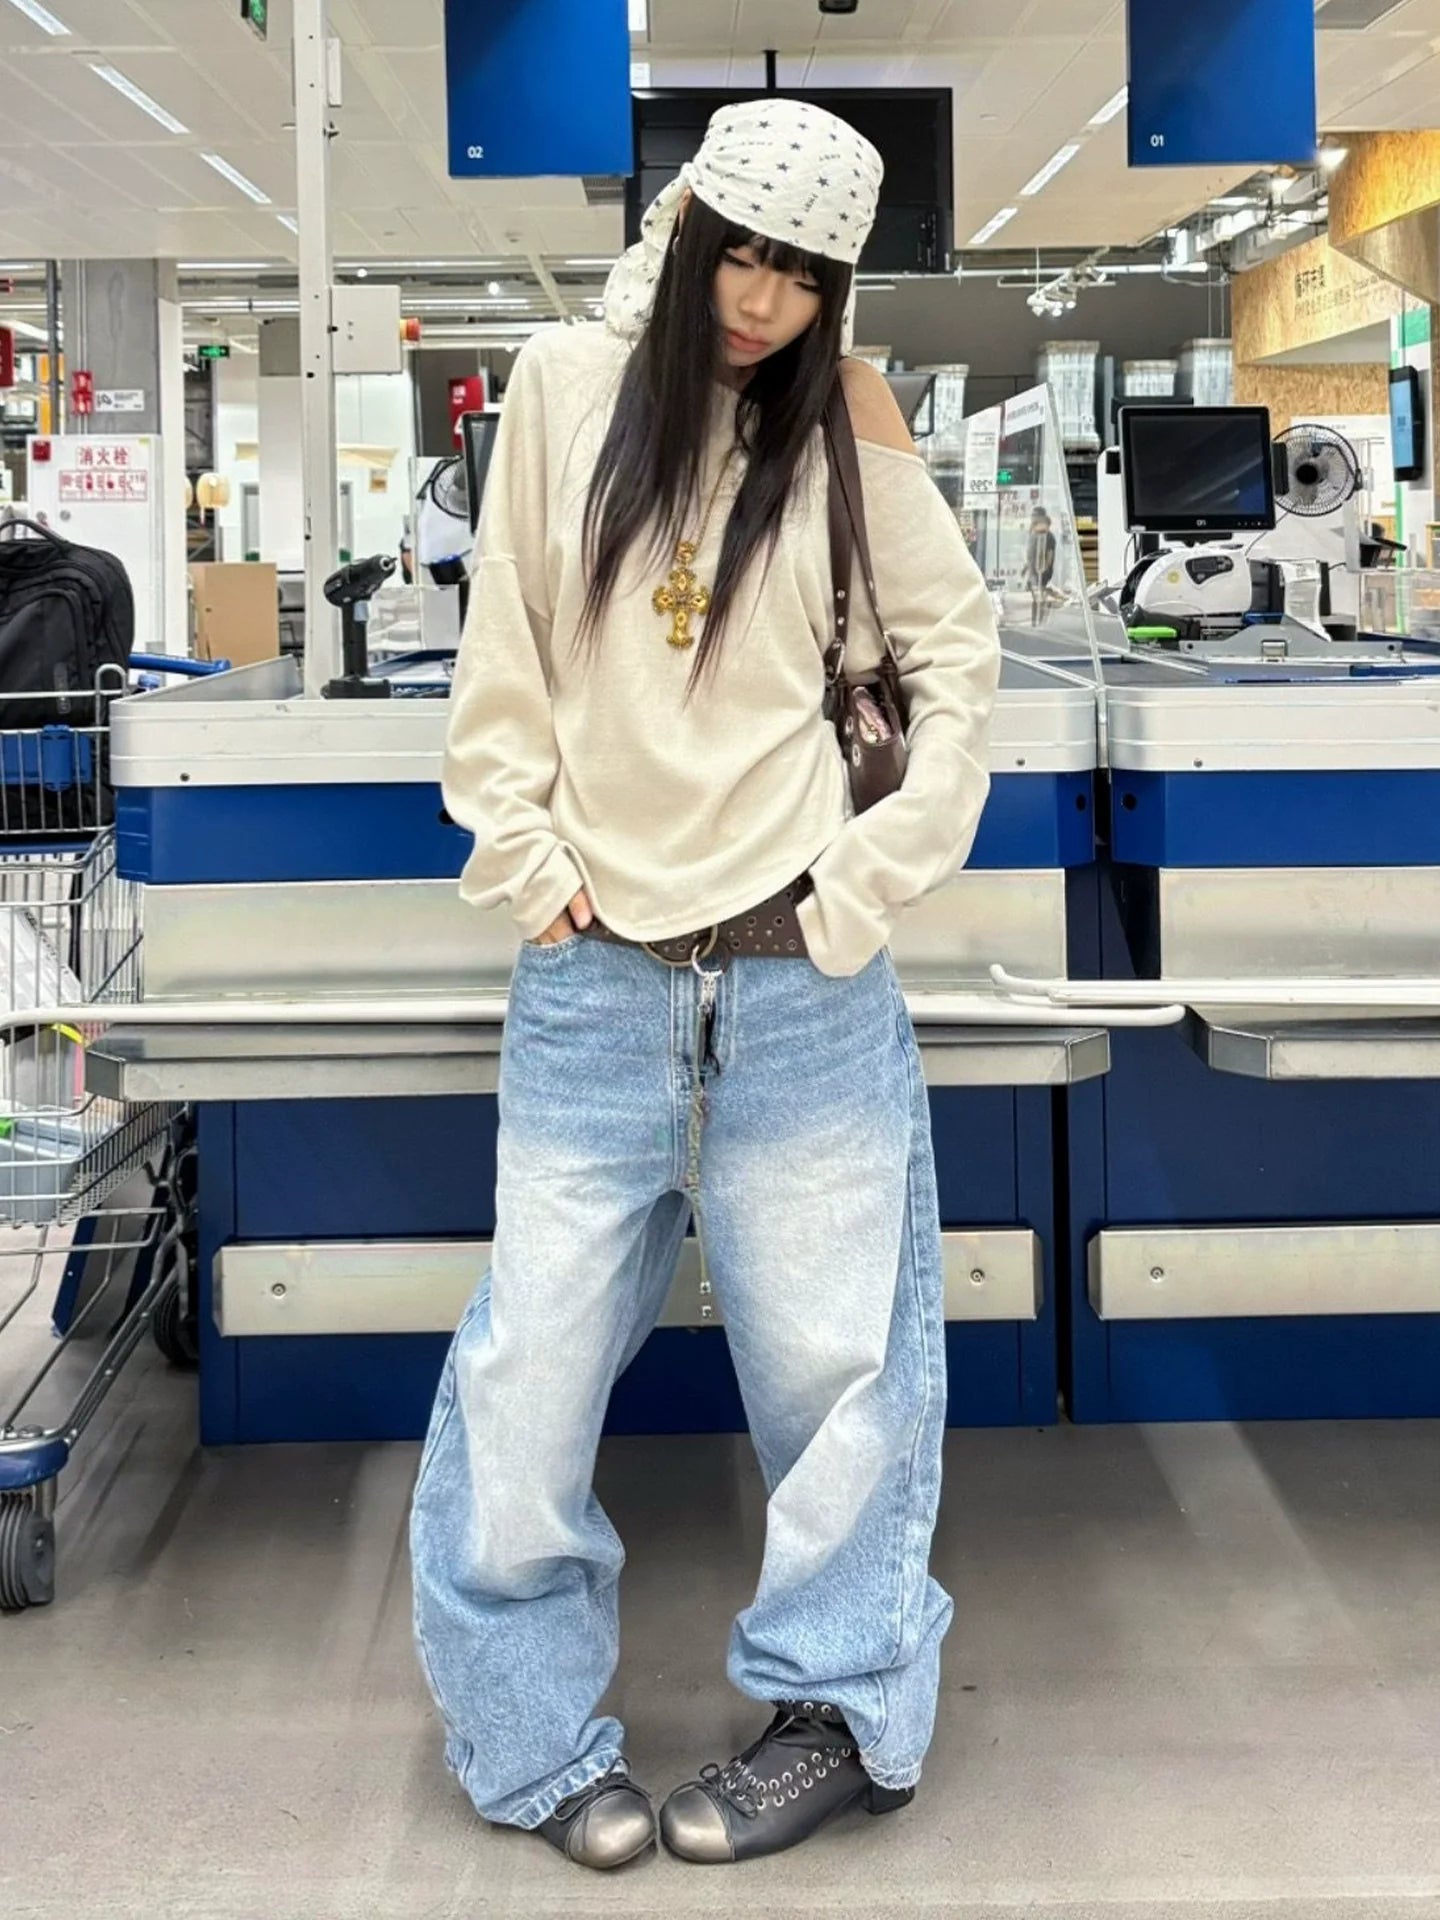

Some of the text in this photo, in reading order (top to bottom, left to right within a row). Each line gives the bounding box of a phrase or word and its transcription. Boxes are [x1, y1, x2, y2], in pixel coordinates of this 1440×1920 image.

[1150, 134, 1164, 147] 01
[467, 145, 484, 159] 02
[79, 447, 128, 465] 消火栓
